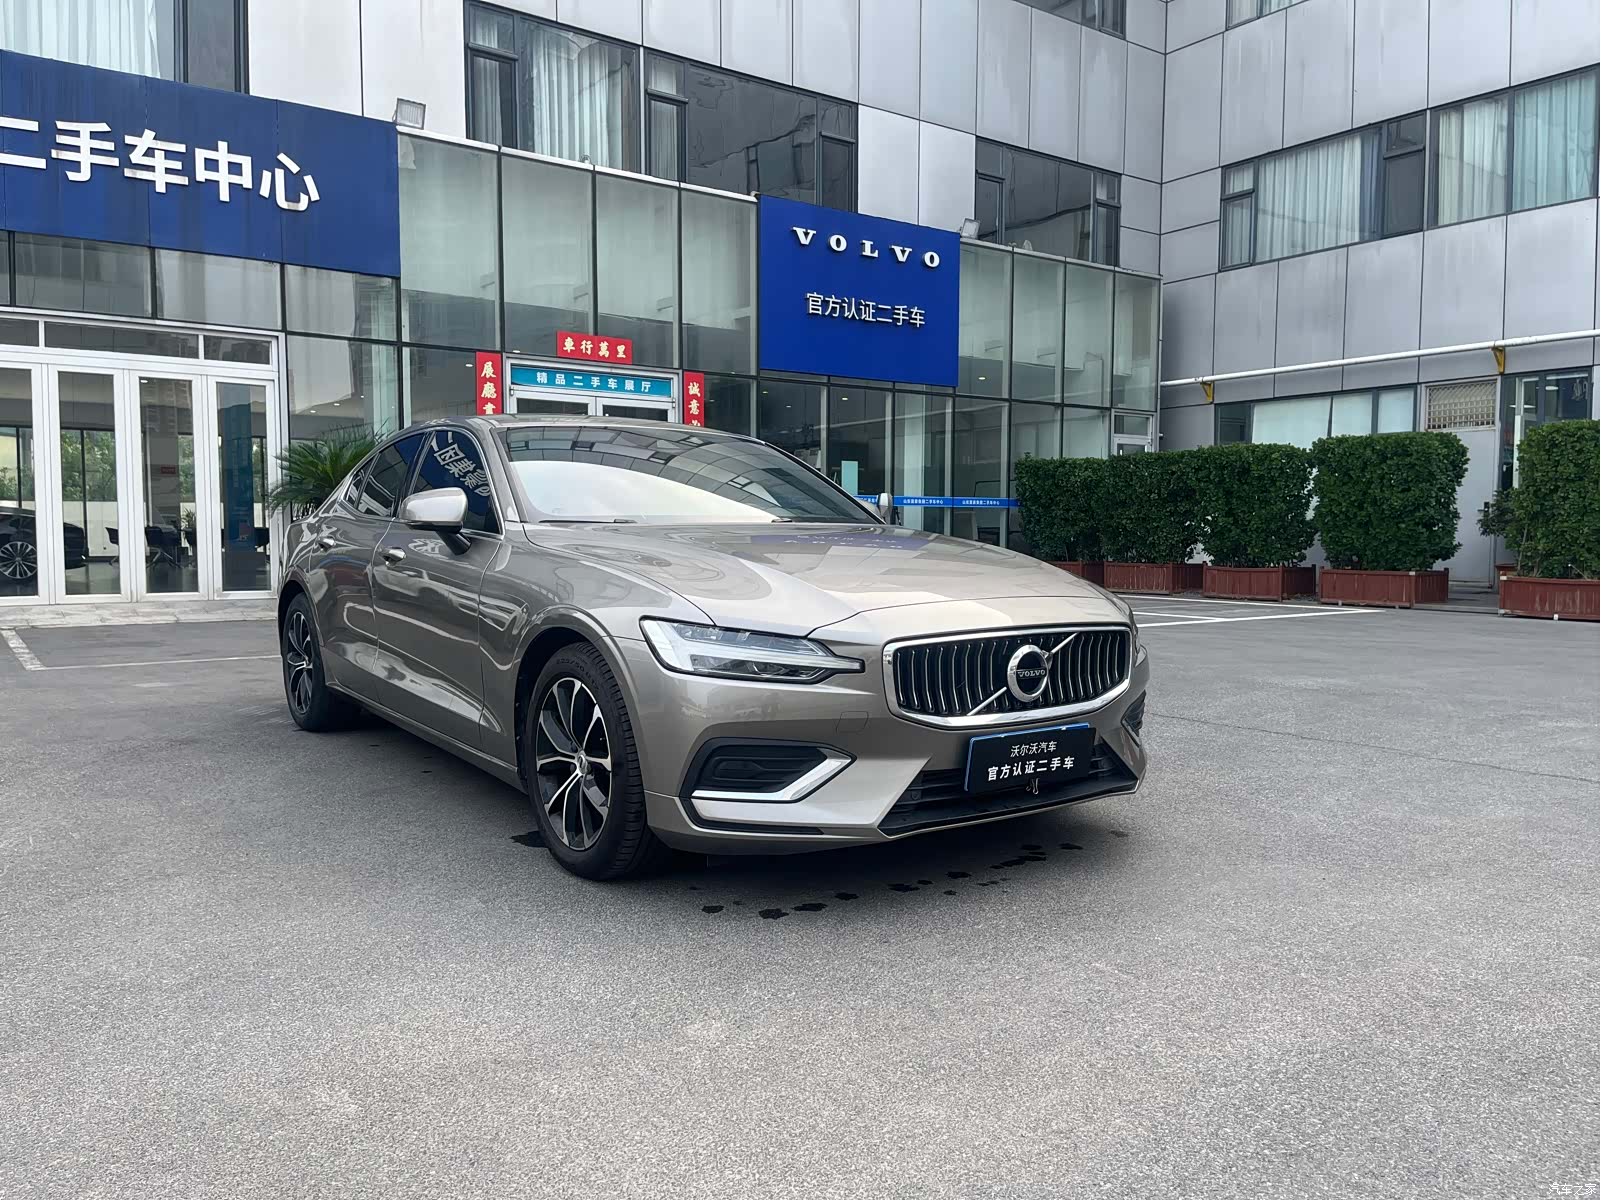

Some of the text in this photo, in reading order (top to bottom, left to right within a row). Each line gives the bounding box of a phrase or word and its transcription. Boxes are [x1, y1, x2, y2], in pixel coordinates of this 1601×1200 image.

[0, 116, 320, 212] 二手车中心
[793, 226, 941, 268] VOLVO
[806, 291, 925, 328] 官方认证二手车
[562, 336, 627, 359] 車行萬里
[536, 371, 652, 392] 精品二手车展厅
[1017, 669, 1046, 678] VOLVO
[1010, 740, 1058, 758] 沃尔沃汽车
[987, 755, 1075, 782] 官方认证二手车
